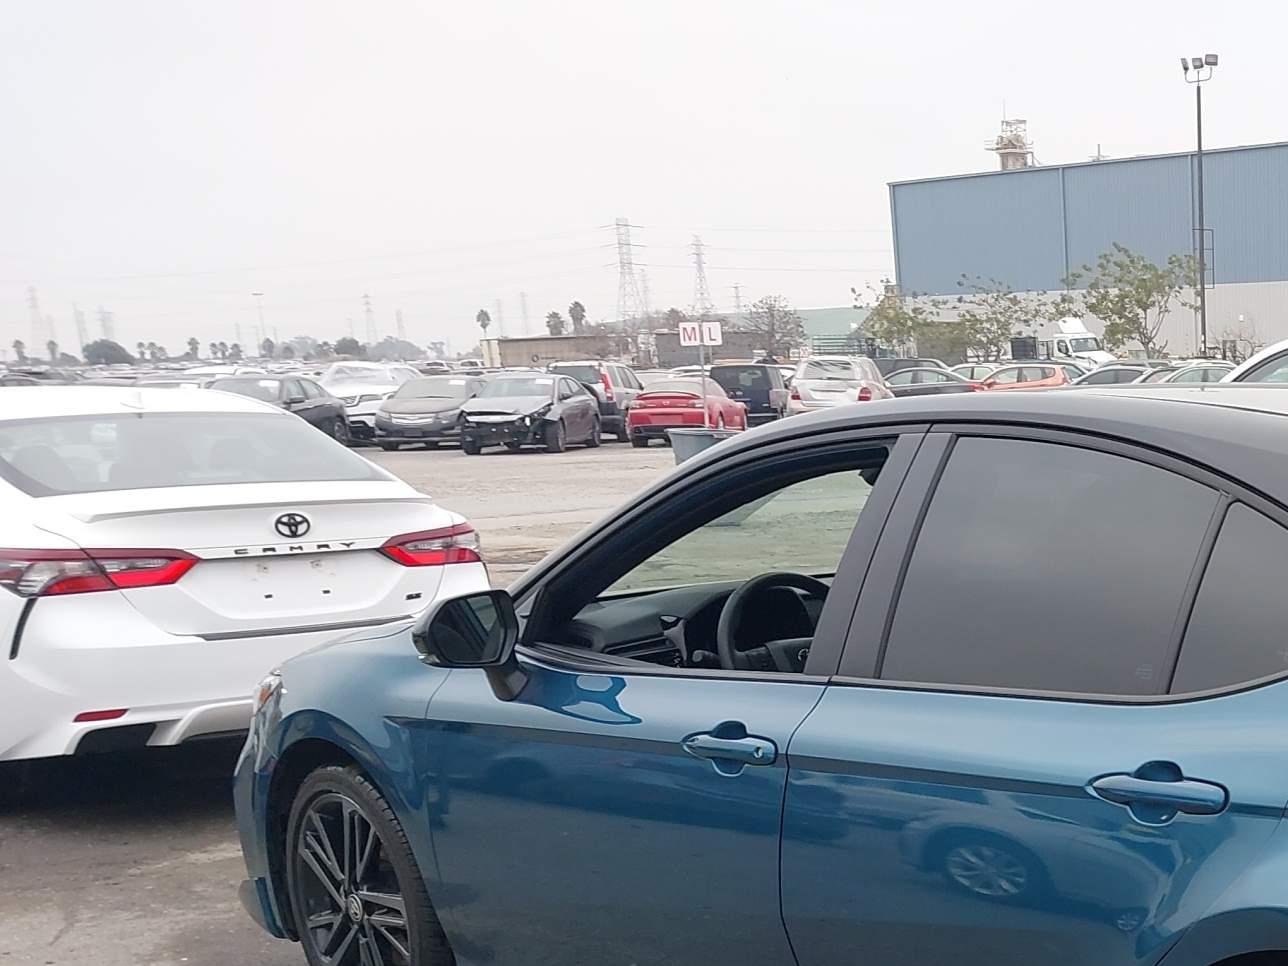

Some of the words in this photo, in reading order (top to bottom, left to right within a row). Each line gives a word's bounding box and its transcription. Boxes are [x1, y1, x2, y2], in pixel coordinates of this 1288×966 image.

[682, 326, 697, 342] M
[706, 326, 717, 341] L
[234, 541, 356, 555] CAMRY
